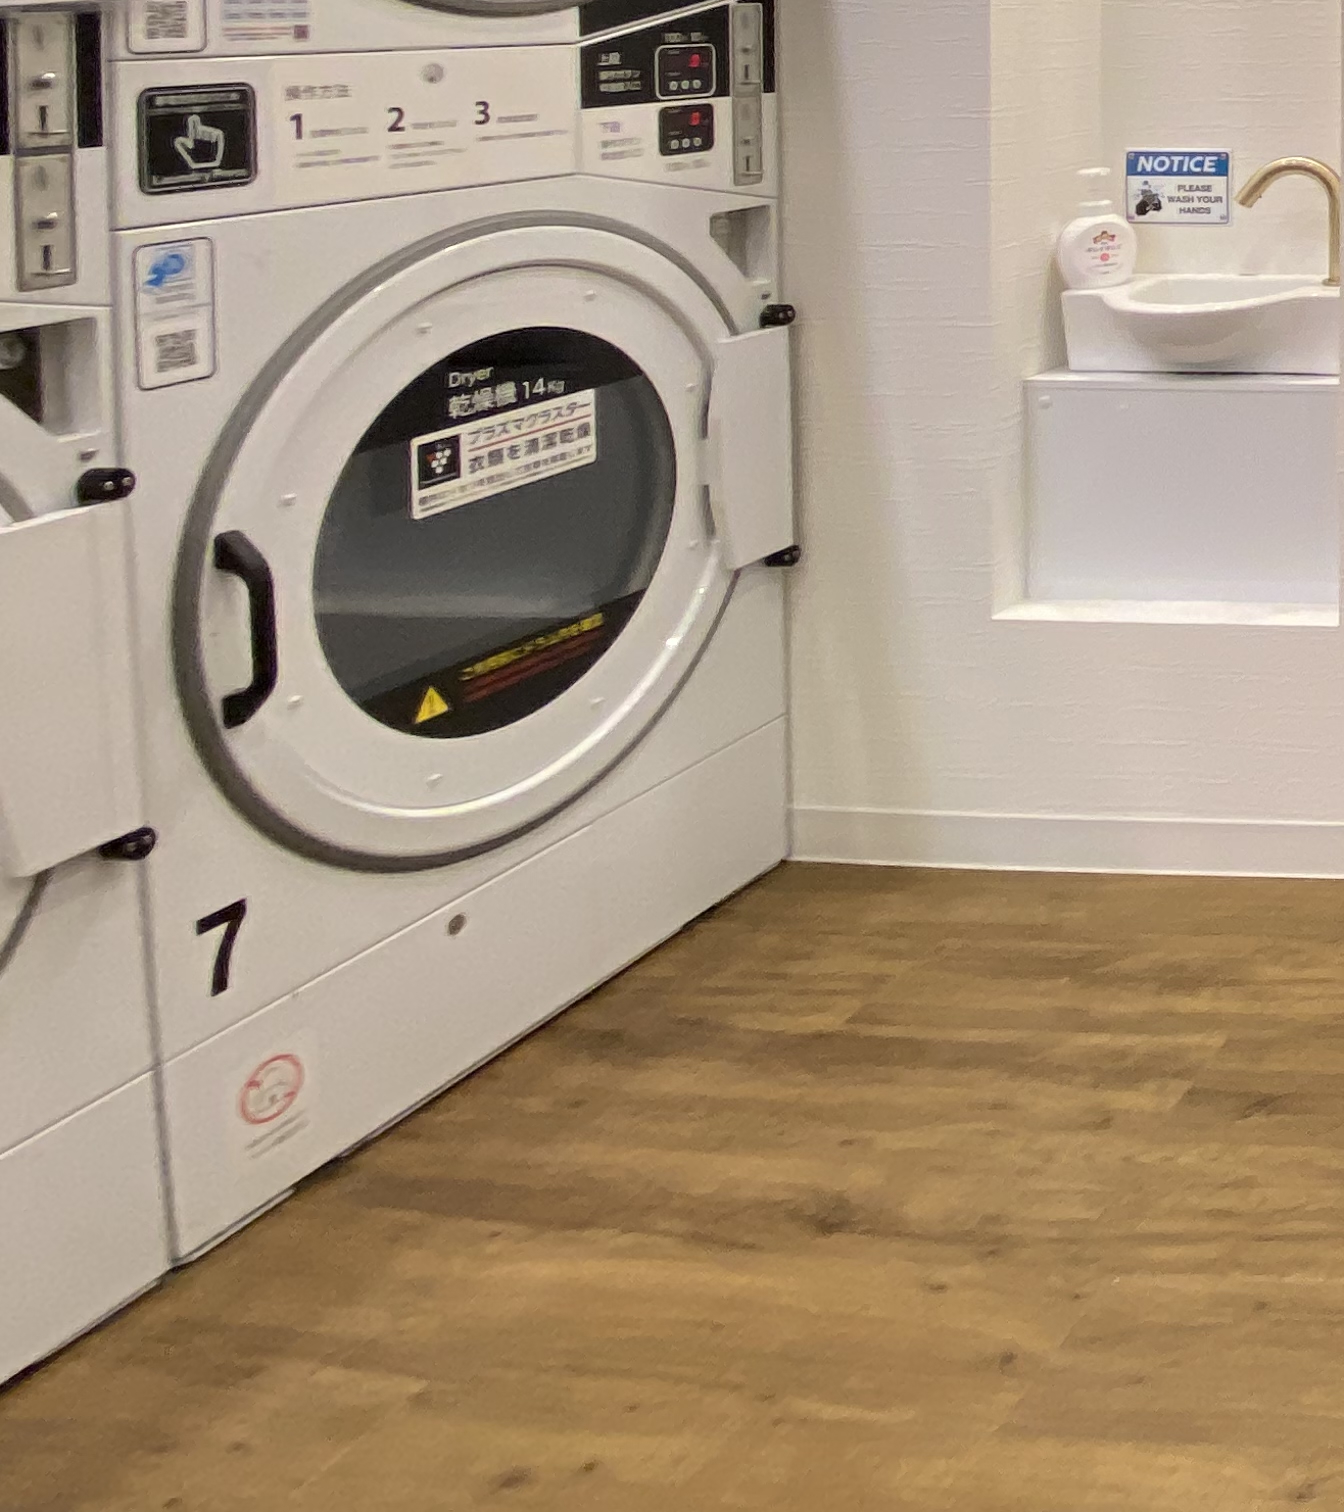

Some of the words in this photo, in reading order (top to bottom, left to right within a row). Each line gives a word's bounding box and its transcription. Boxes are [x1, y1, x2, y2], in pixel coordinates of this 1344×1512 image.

[388, 107, 405, 132] 2
[475, 101, 490, 125] 3
[290, 113, 303, 140] 1
[1136, 155, 1218, 173] NOTICE
[1167, 195, 1194, 204] WASH
[1197, 195, 1223, 204] YOUR
[1177, 184, 1212, 193] PLEASE
[1179, 206, 1211, 215] HANDS
[449, 366, 494, 388] Dryer
[196, 898, 247, 997] 7
